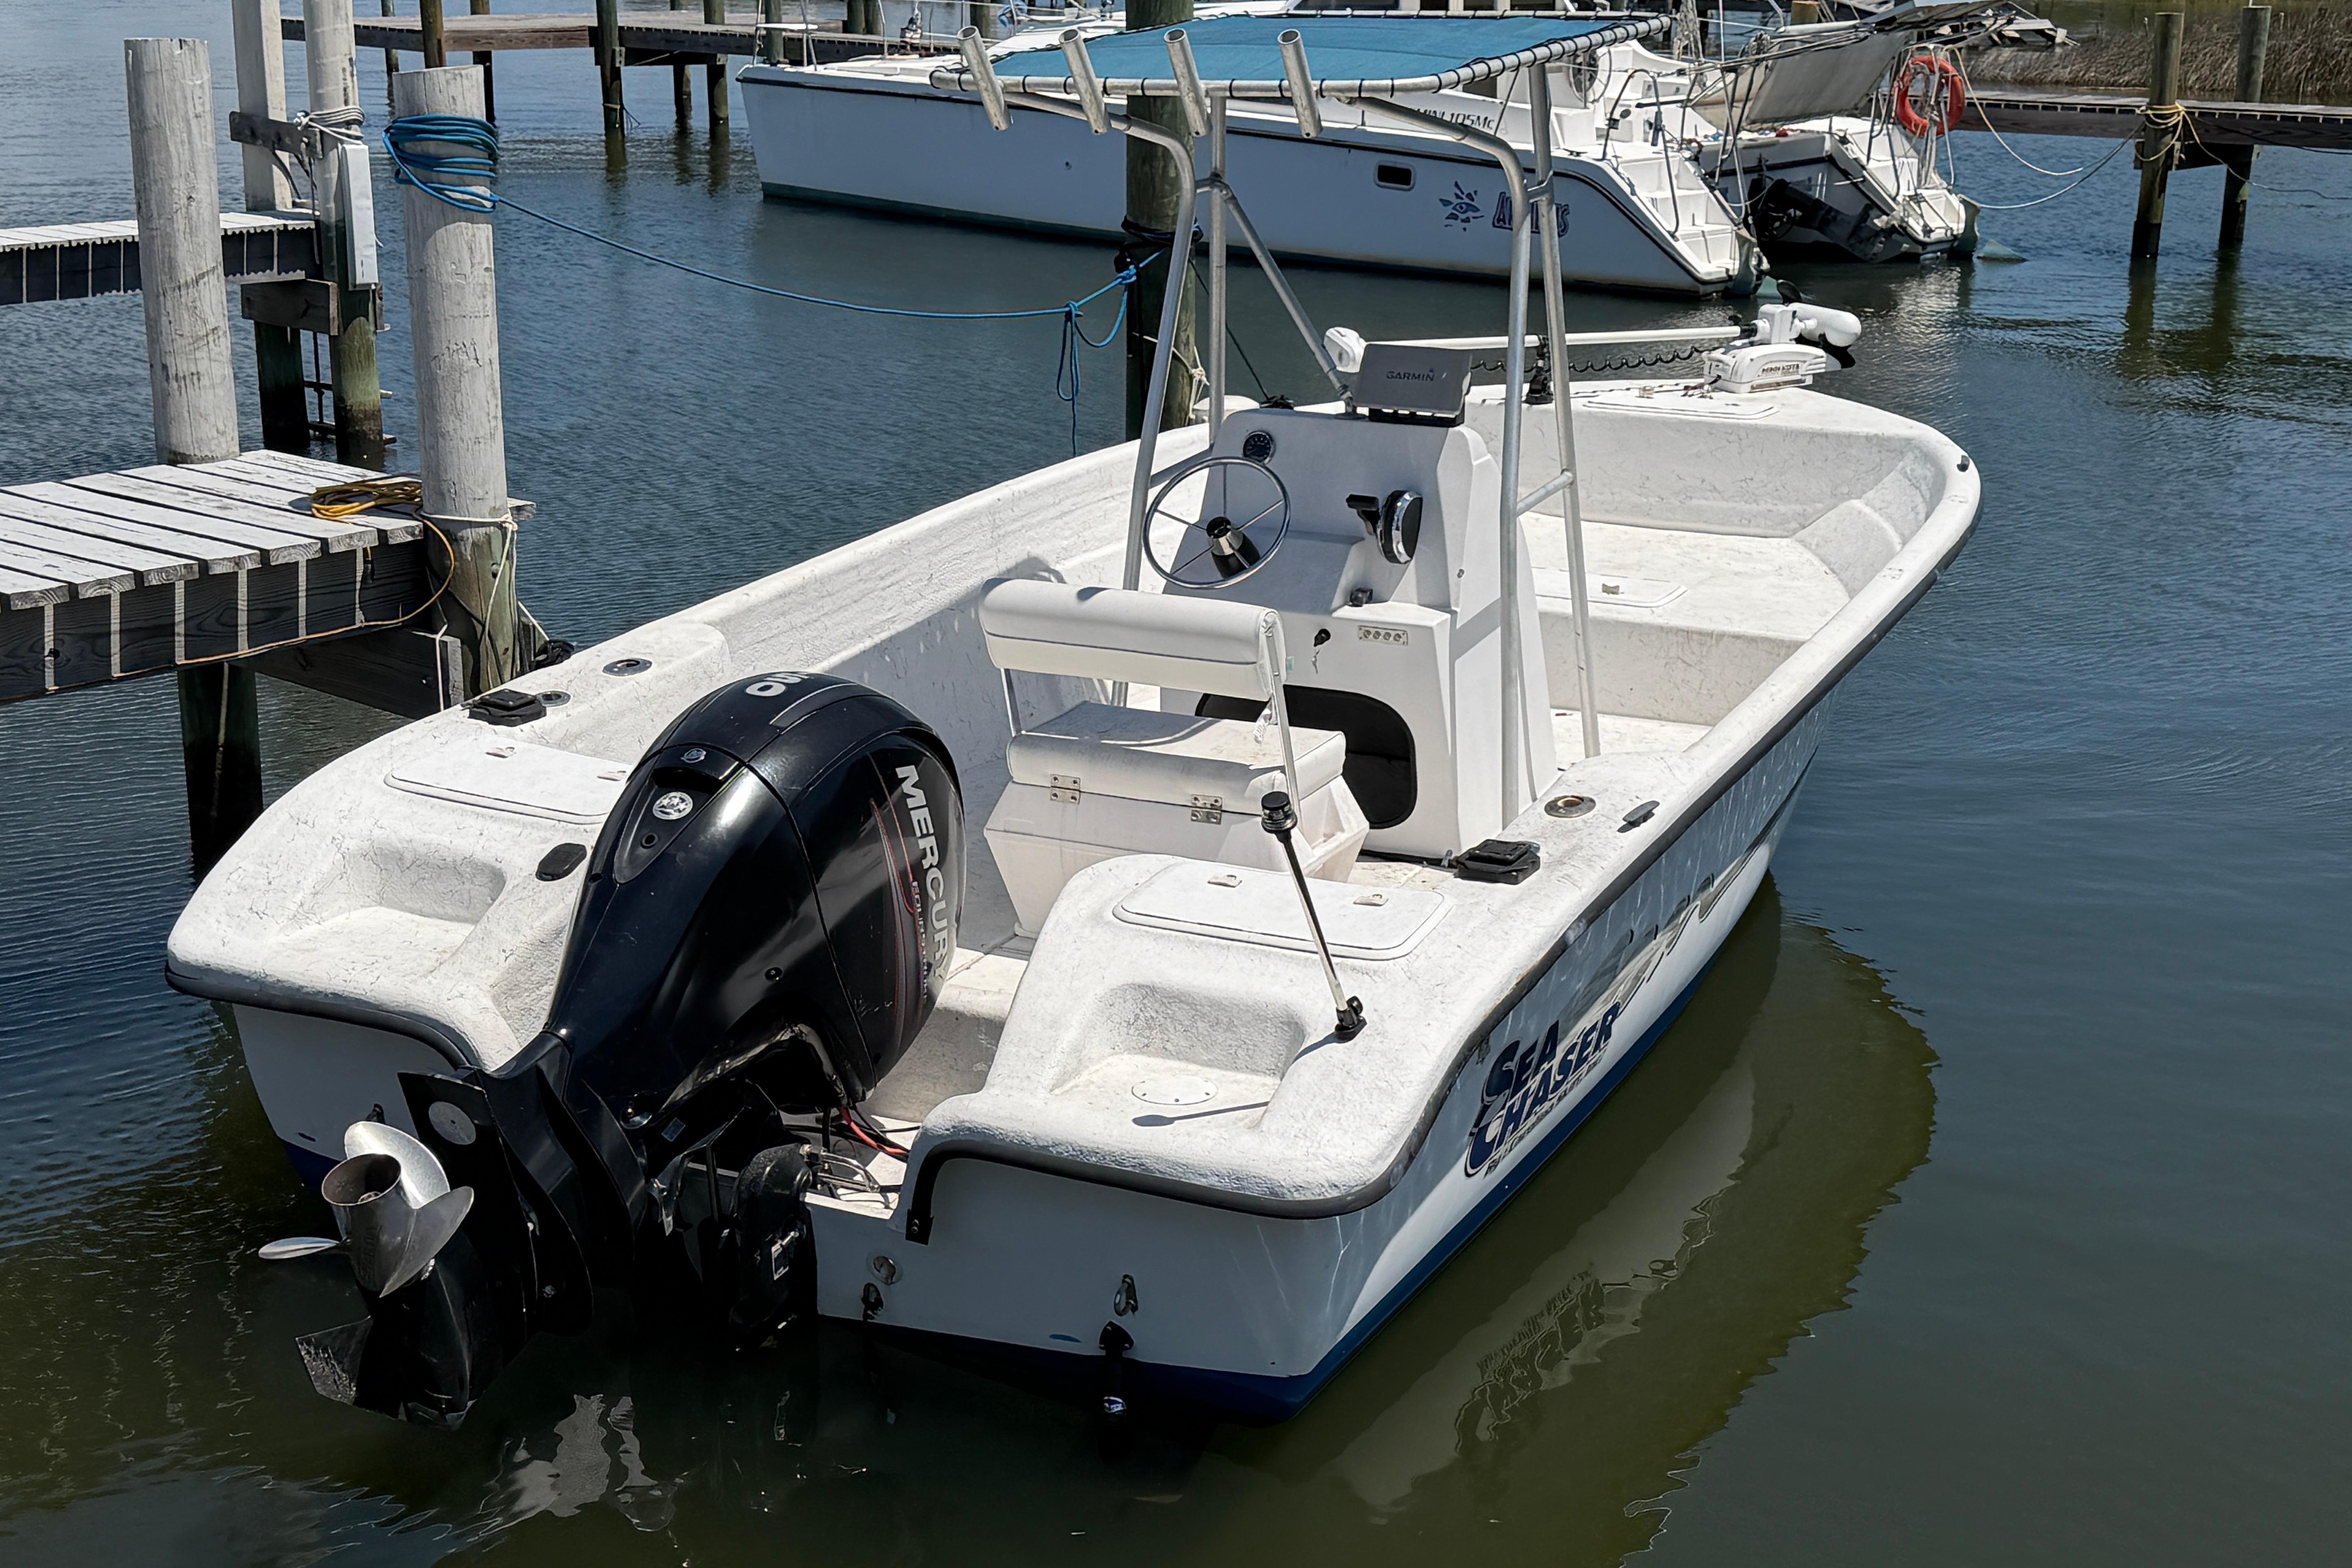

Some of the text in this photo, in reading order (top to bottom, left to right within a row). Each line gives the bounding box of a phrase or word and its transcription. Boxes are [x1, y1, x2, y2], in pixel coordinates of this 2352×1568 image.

[1386, 370, 1435, 382] GARMIN
[895, 765, 948, 980] MERCURY
[1465, 1001, 1621, 1176] CHASER
[1484, 1019, 1559, 1101] SEA
